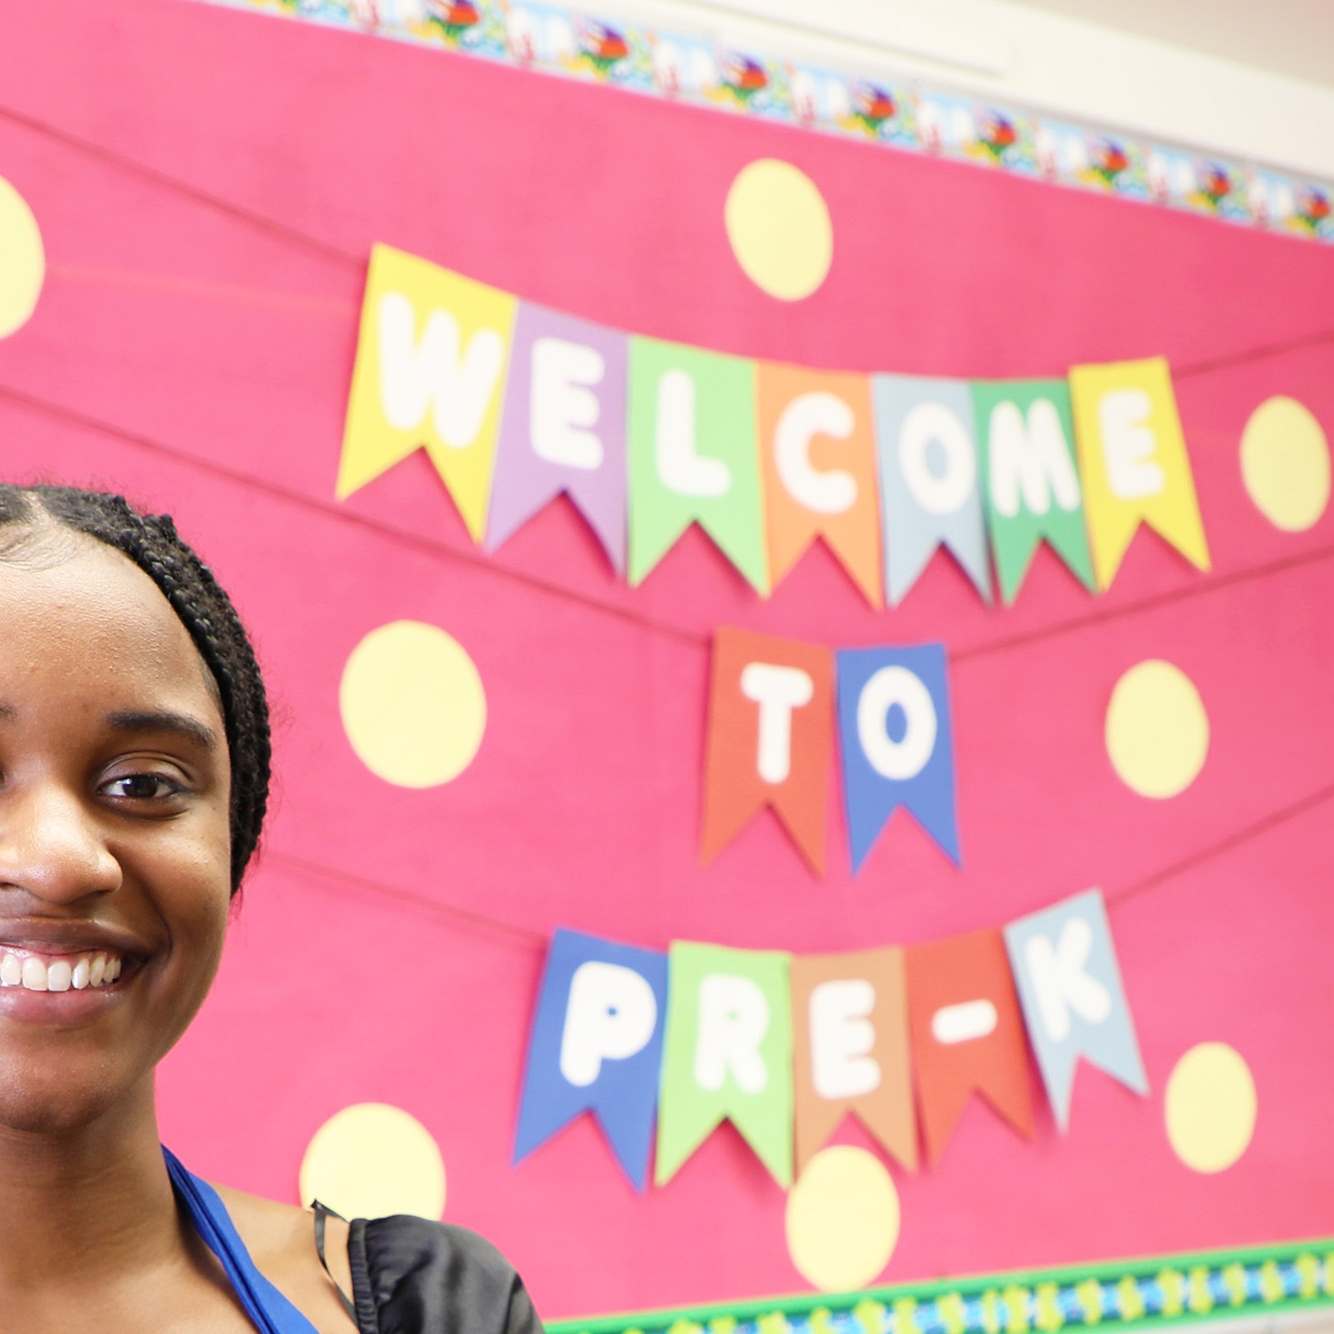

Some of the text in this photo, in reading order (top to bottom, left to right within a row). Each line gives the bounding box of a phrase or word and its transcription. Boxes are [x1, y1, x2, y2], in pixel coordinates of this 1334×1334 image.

[377, 291, 1166, 518] WELCOME
[740, 661, 938, 784] TO
[559, 917, 1112, 1100] PRE-K
